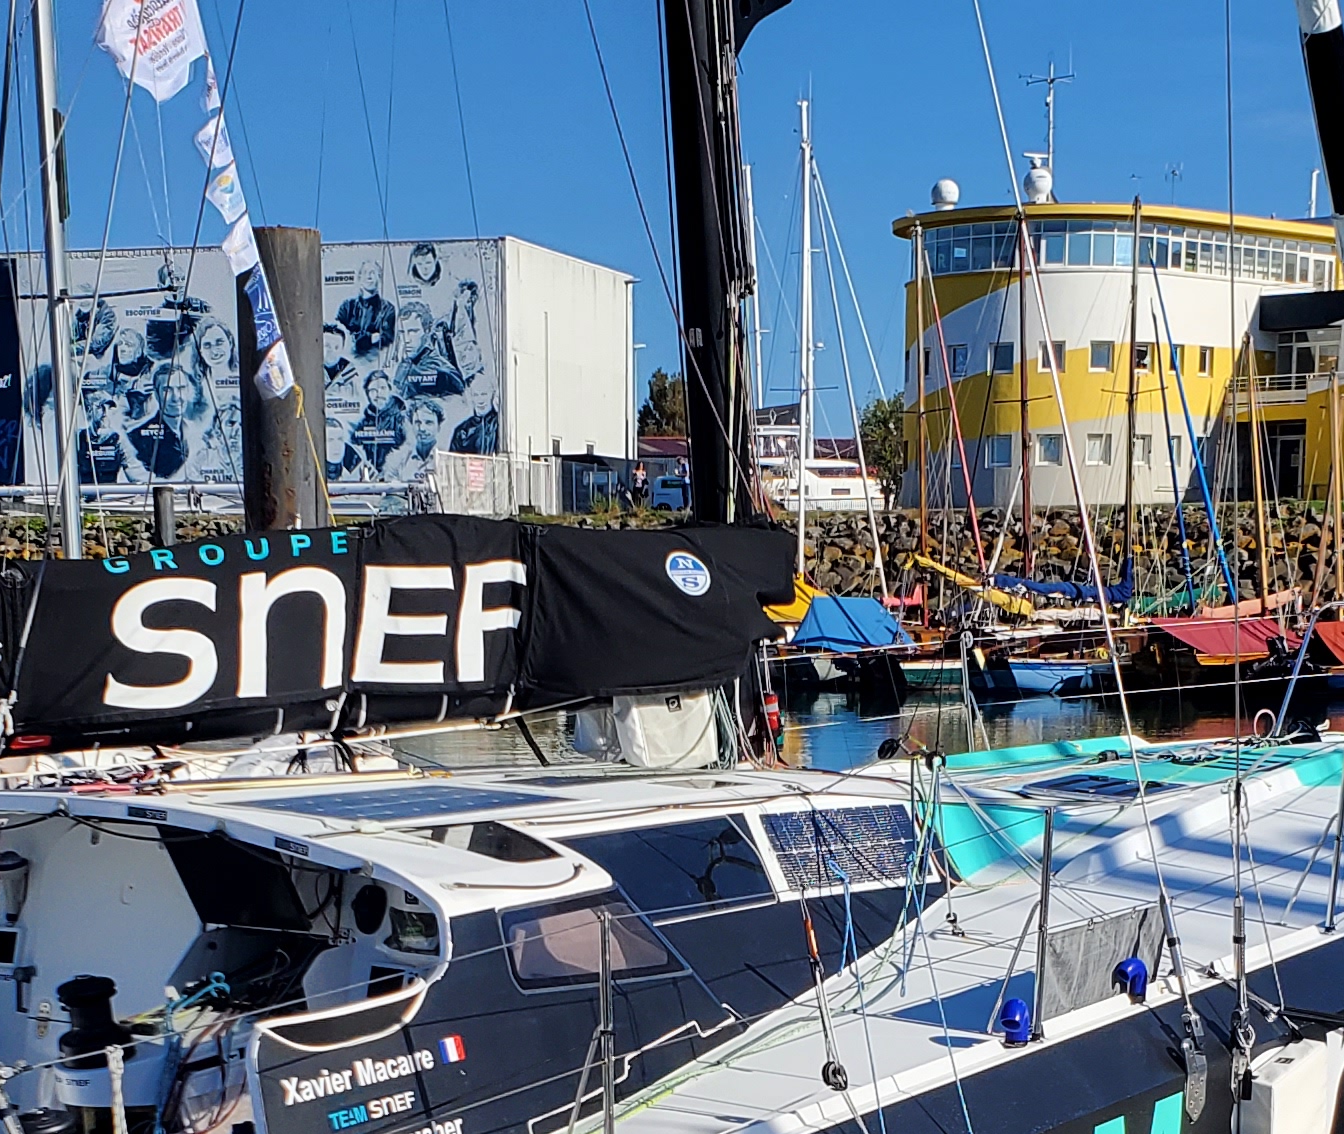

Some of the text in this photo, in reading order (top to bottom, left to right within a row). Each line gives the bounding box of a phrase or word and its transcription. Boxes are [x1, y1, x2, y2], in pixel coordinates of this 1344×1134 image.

[103, 530, 349, 574] GROUPE
[280, 1049, 435, 1106] Xavier Macaire
[328, 1105, 369, 1131] TEAM
